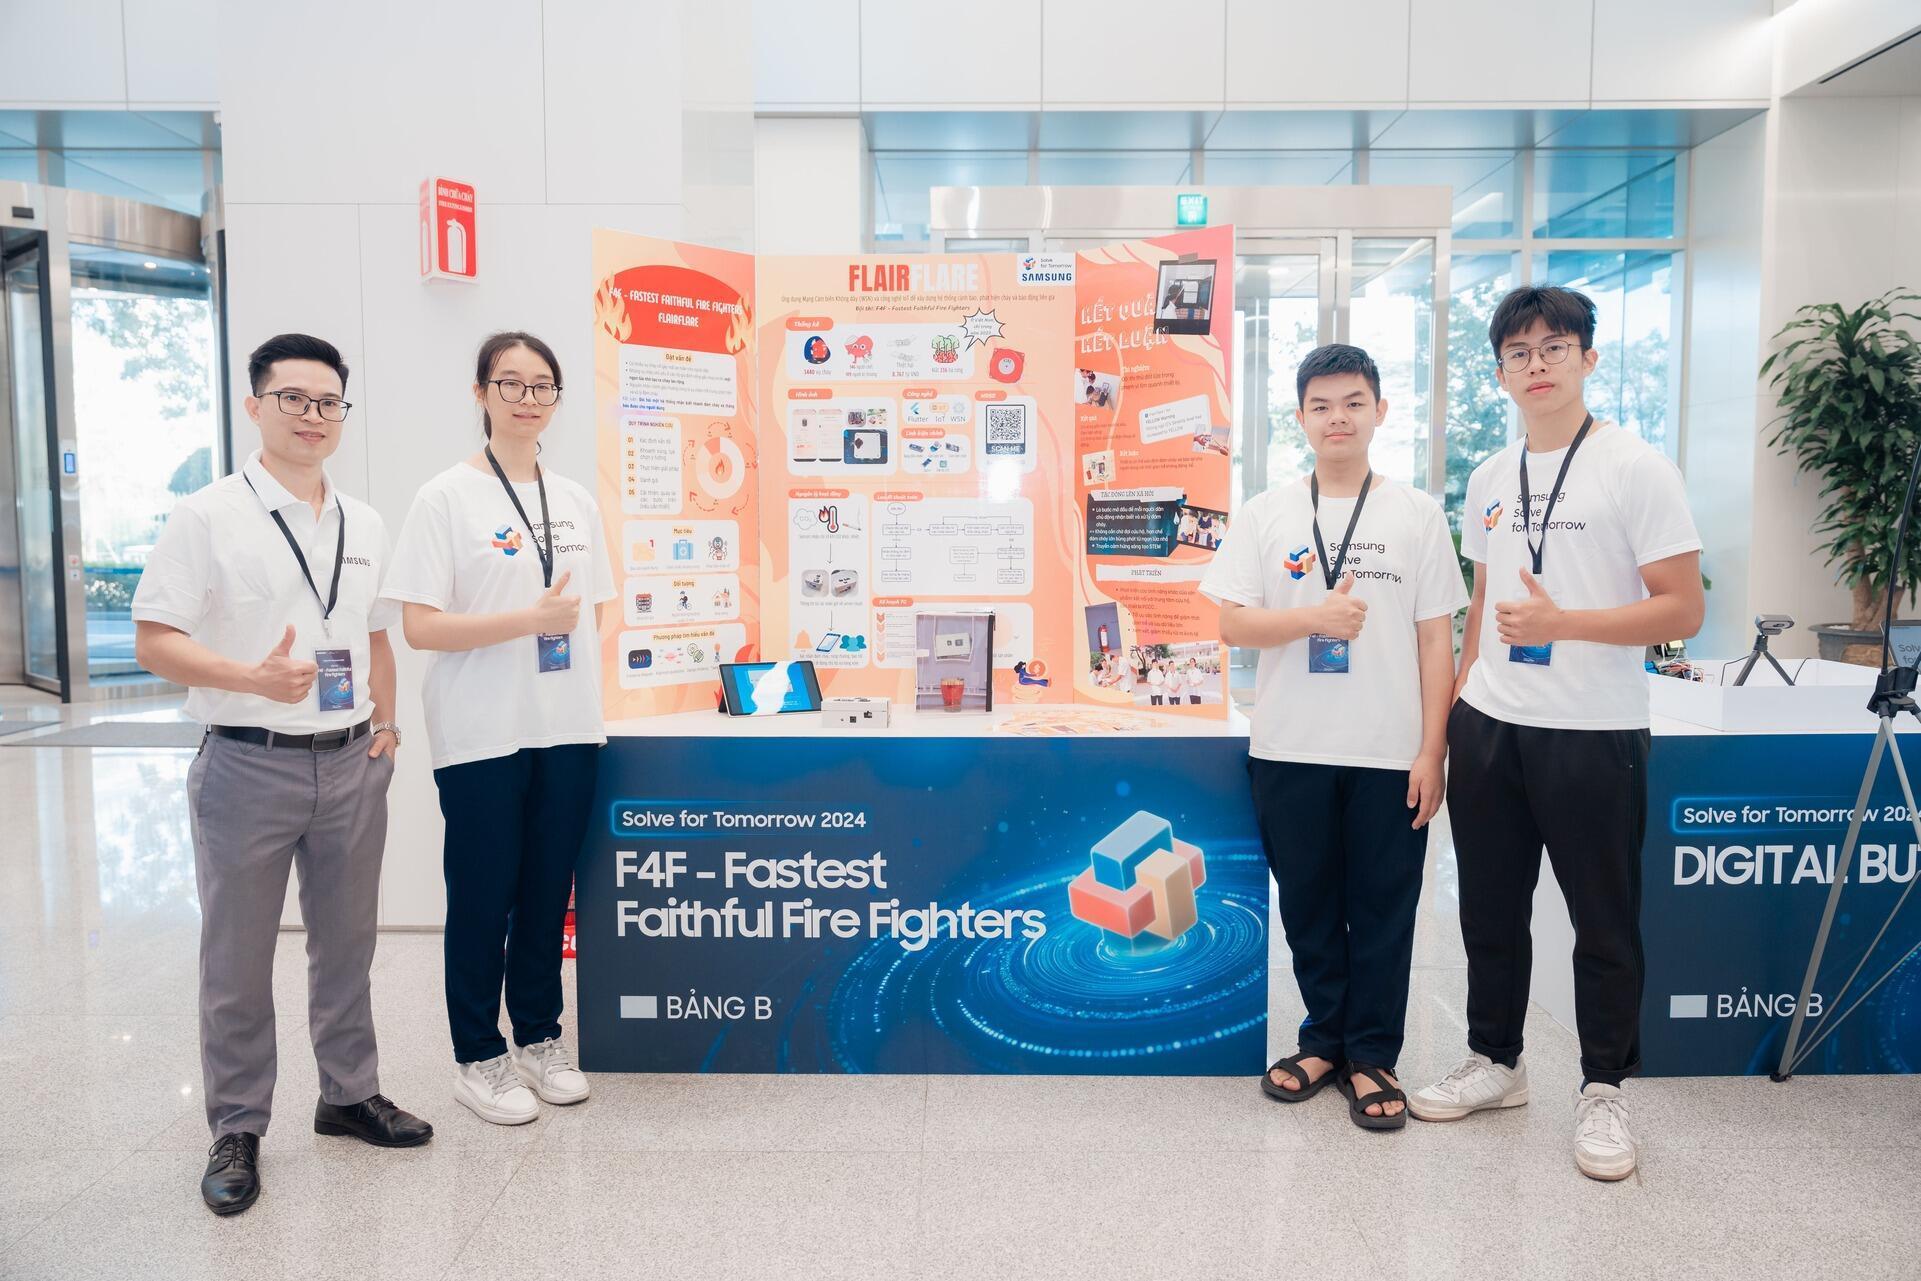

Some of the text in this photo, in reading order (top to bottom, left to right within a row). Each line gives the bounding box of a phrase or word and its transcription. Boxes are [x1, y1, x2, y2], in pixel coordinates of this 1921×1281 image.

[1022, 273, 1072, 281] SAMSUNG
[630, 290, 659, 303] FASTEST
[661, 294, 694, 308] FAITHFUL
[696, 299, 710, 311] FIRE
[712, 301, 743, 316] FIGHTERS
[658, 313, 699, 327] FLAIRFLARE
[1516, 492, 1565, 503] Smsug
[1514, 508, 1542, 517] Sove
[1330, 556, 1361, 565] Slve
[622, 810, 866, 828] Solve for Tomorrow 2024
[1683, 807, 1737, 824] Solve
[1741, 806, 1770, 823] for
[1884, 806, 1921, 822] 202
[616, 851, 687, 888] F4F
[725, 851, 887, 889] Fastest
[1674, 844, 1921, 886] DIGITAL BU
[616, 897, 1047, 952] Faithful Fire Fighters
[666, 989, 772, 1019] BẢNG B
[1717, 986, 1823, 1018] BẢNG B
